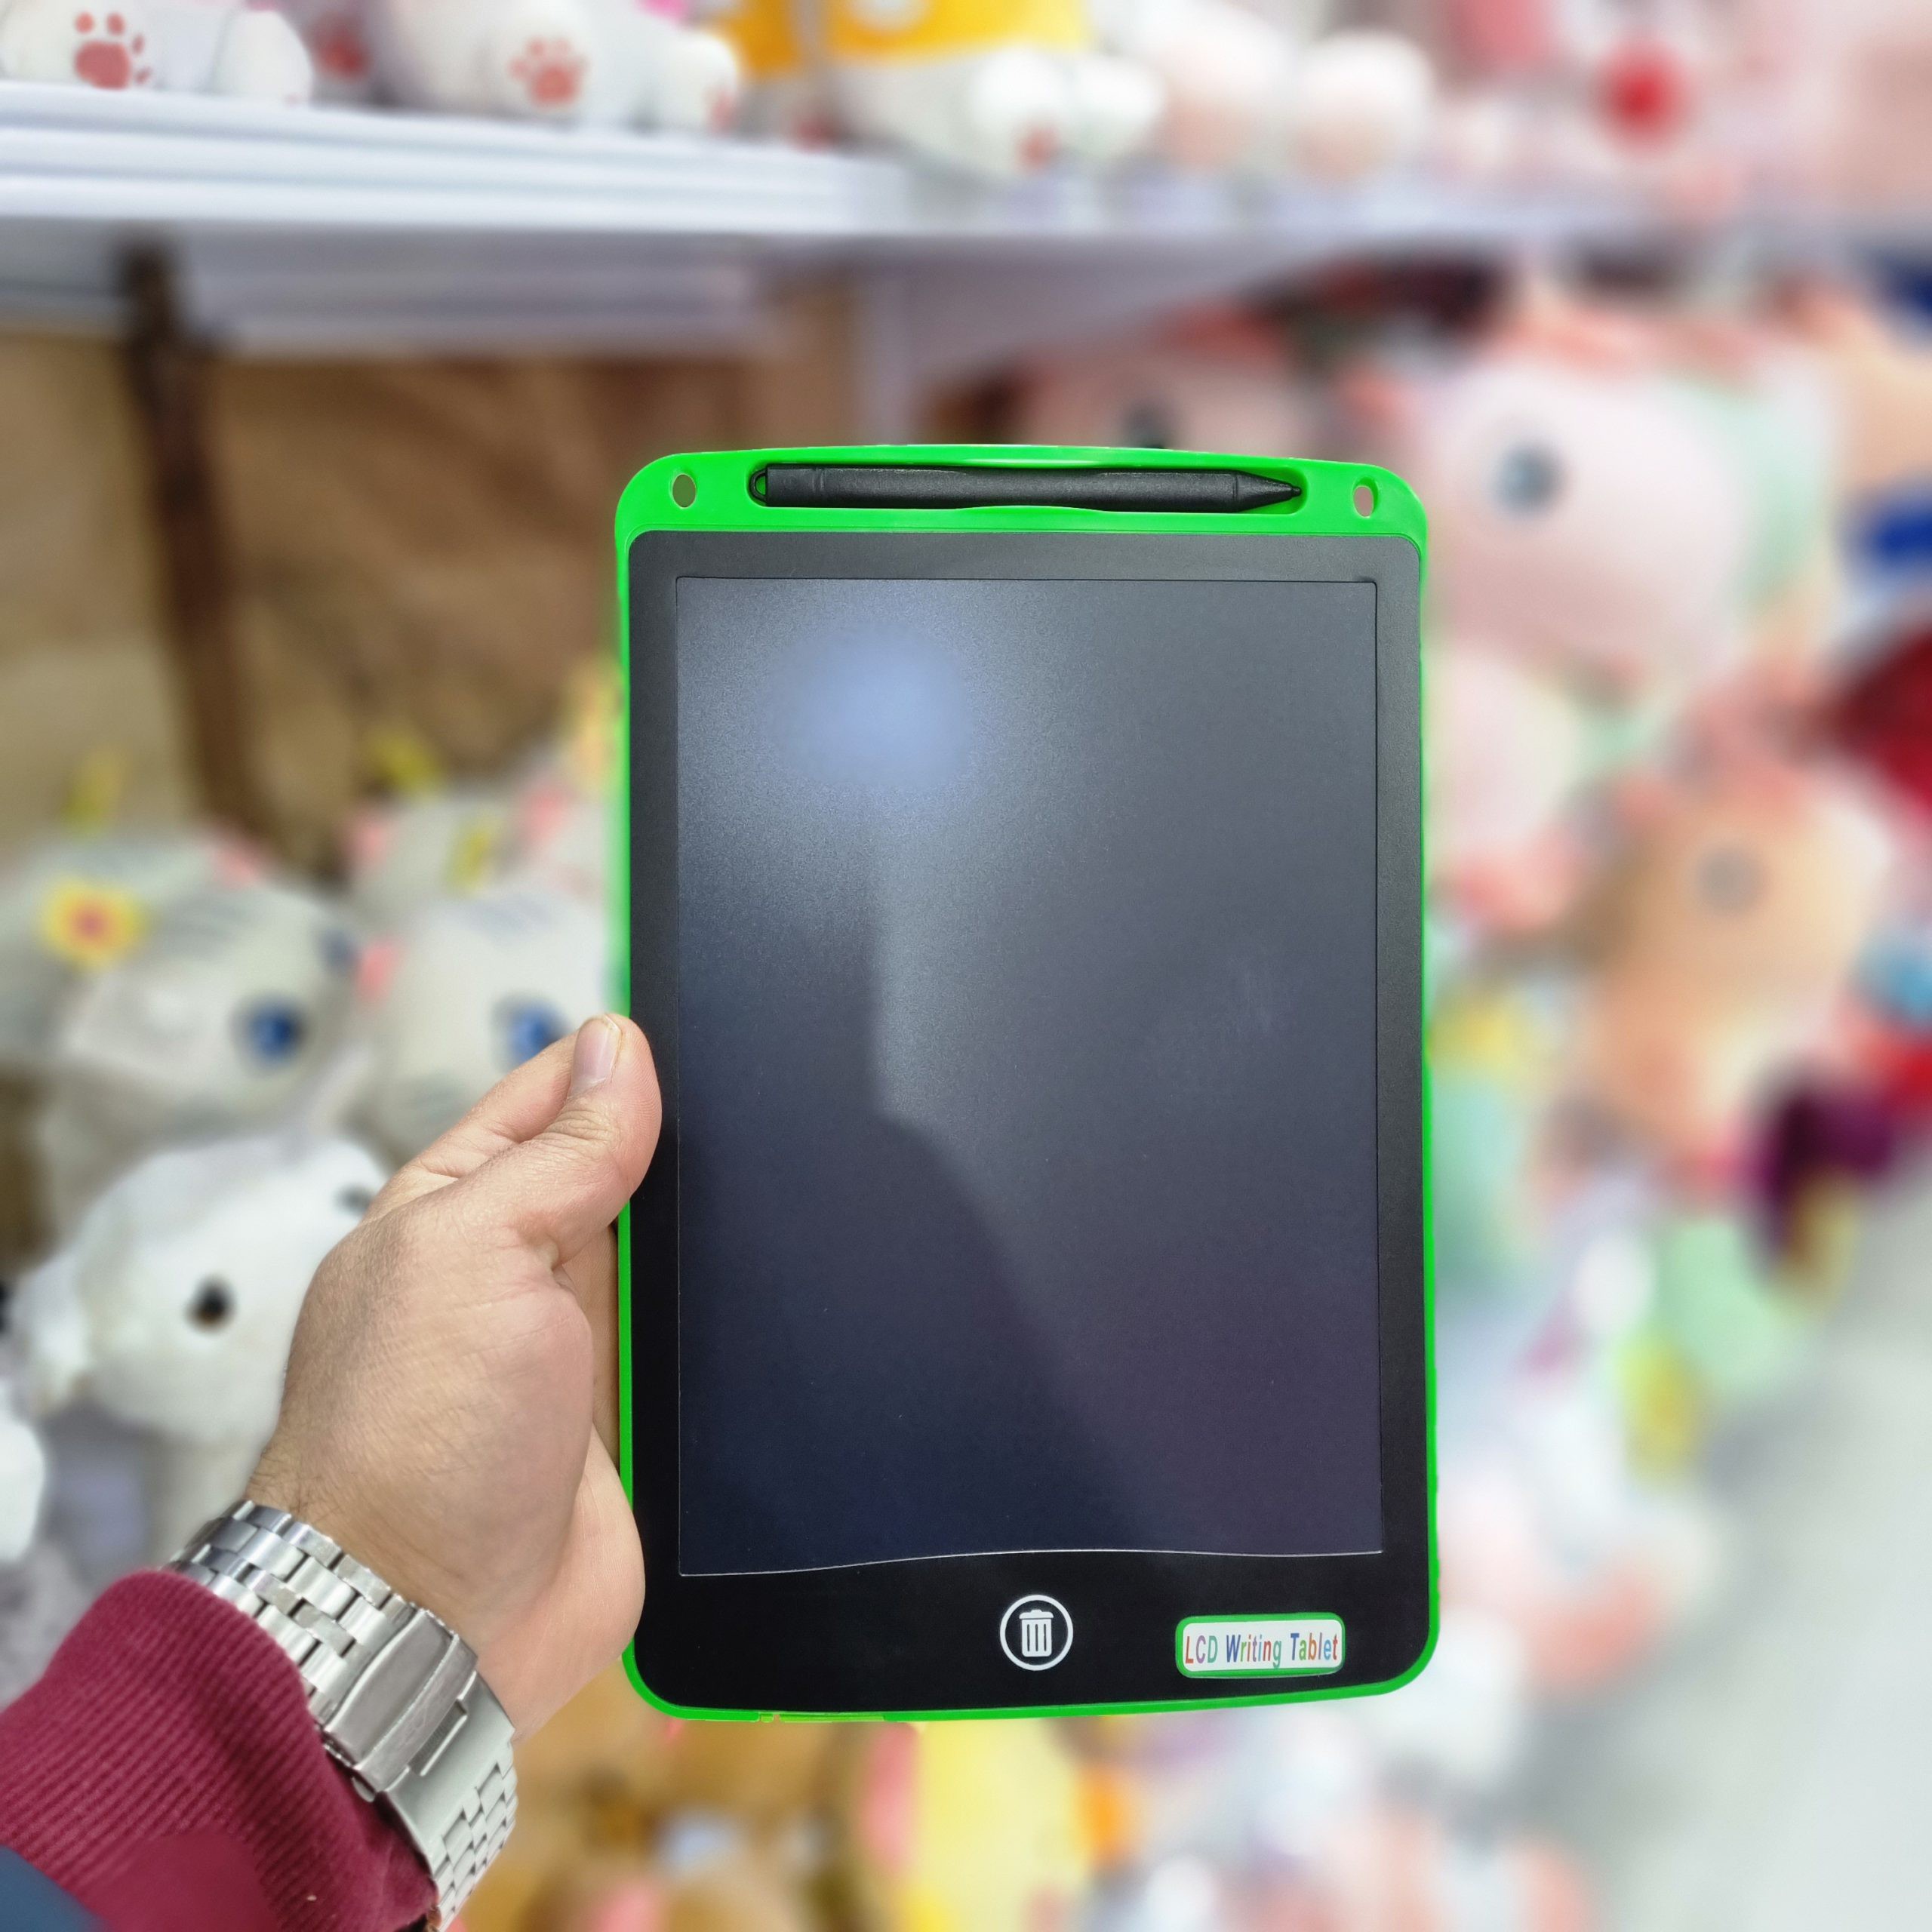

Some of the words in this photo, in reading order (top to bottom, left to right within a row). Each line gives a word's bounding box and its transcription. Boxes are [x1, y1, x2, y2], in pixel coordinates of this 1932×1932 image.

[1185, 1635, 1218, 1664] LCD
[1226, 1634, 1282, 1669] Writing
[1290, 1632, 1338, 1661] Tablet
